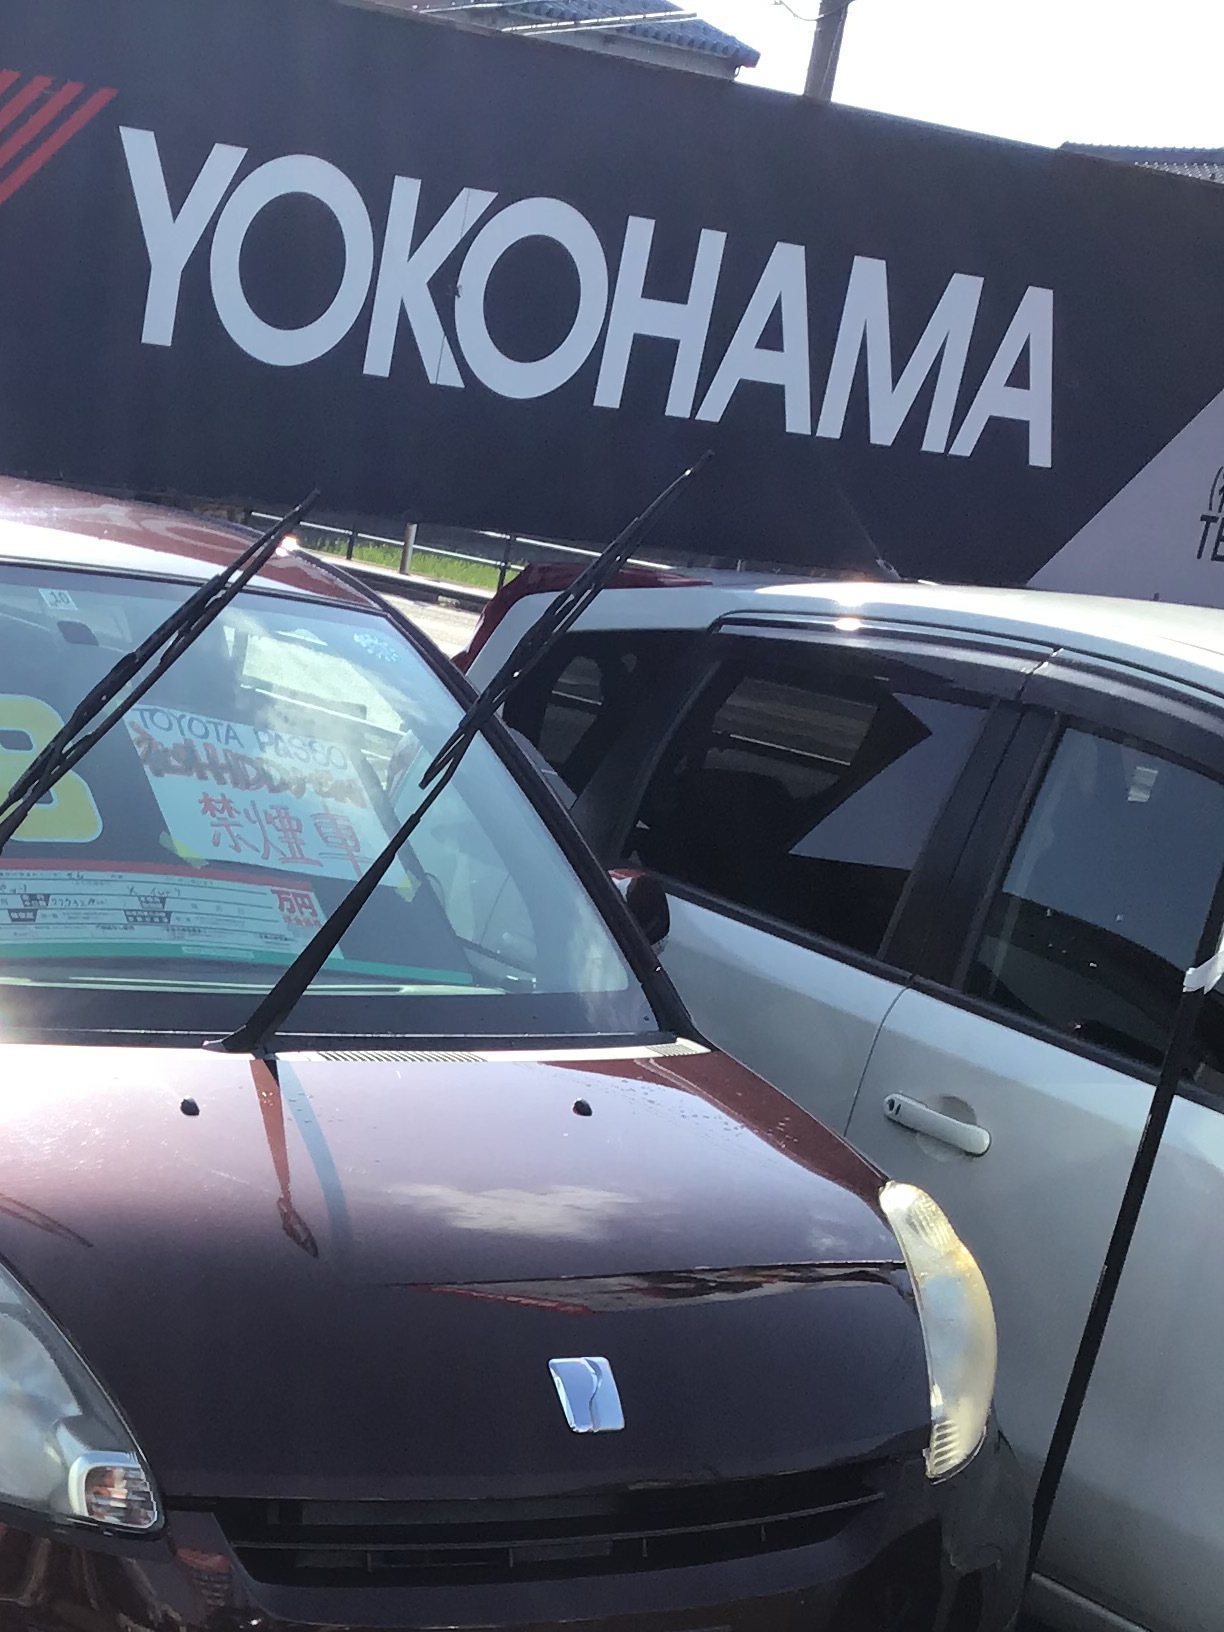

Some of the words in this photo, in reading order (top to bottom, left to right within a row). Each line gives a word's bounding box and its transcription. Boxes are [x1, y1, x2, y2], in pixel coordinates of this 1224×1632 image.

[119, 125, 1055, 469] YOKOHAMA
[131, 707, 244, 749] TOYOTA
[197, 791, 375, 879] 禁煙車
[270, 888, 318, 917] 万円
